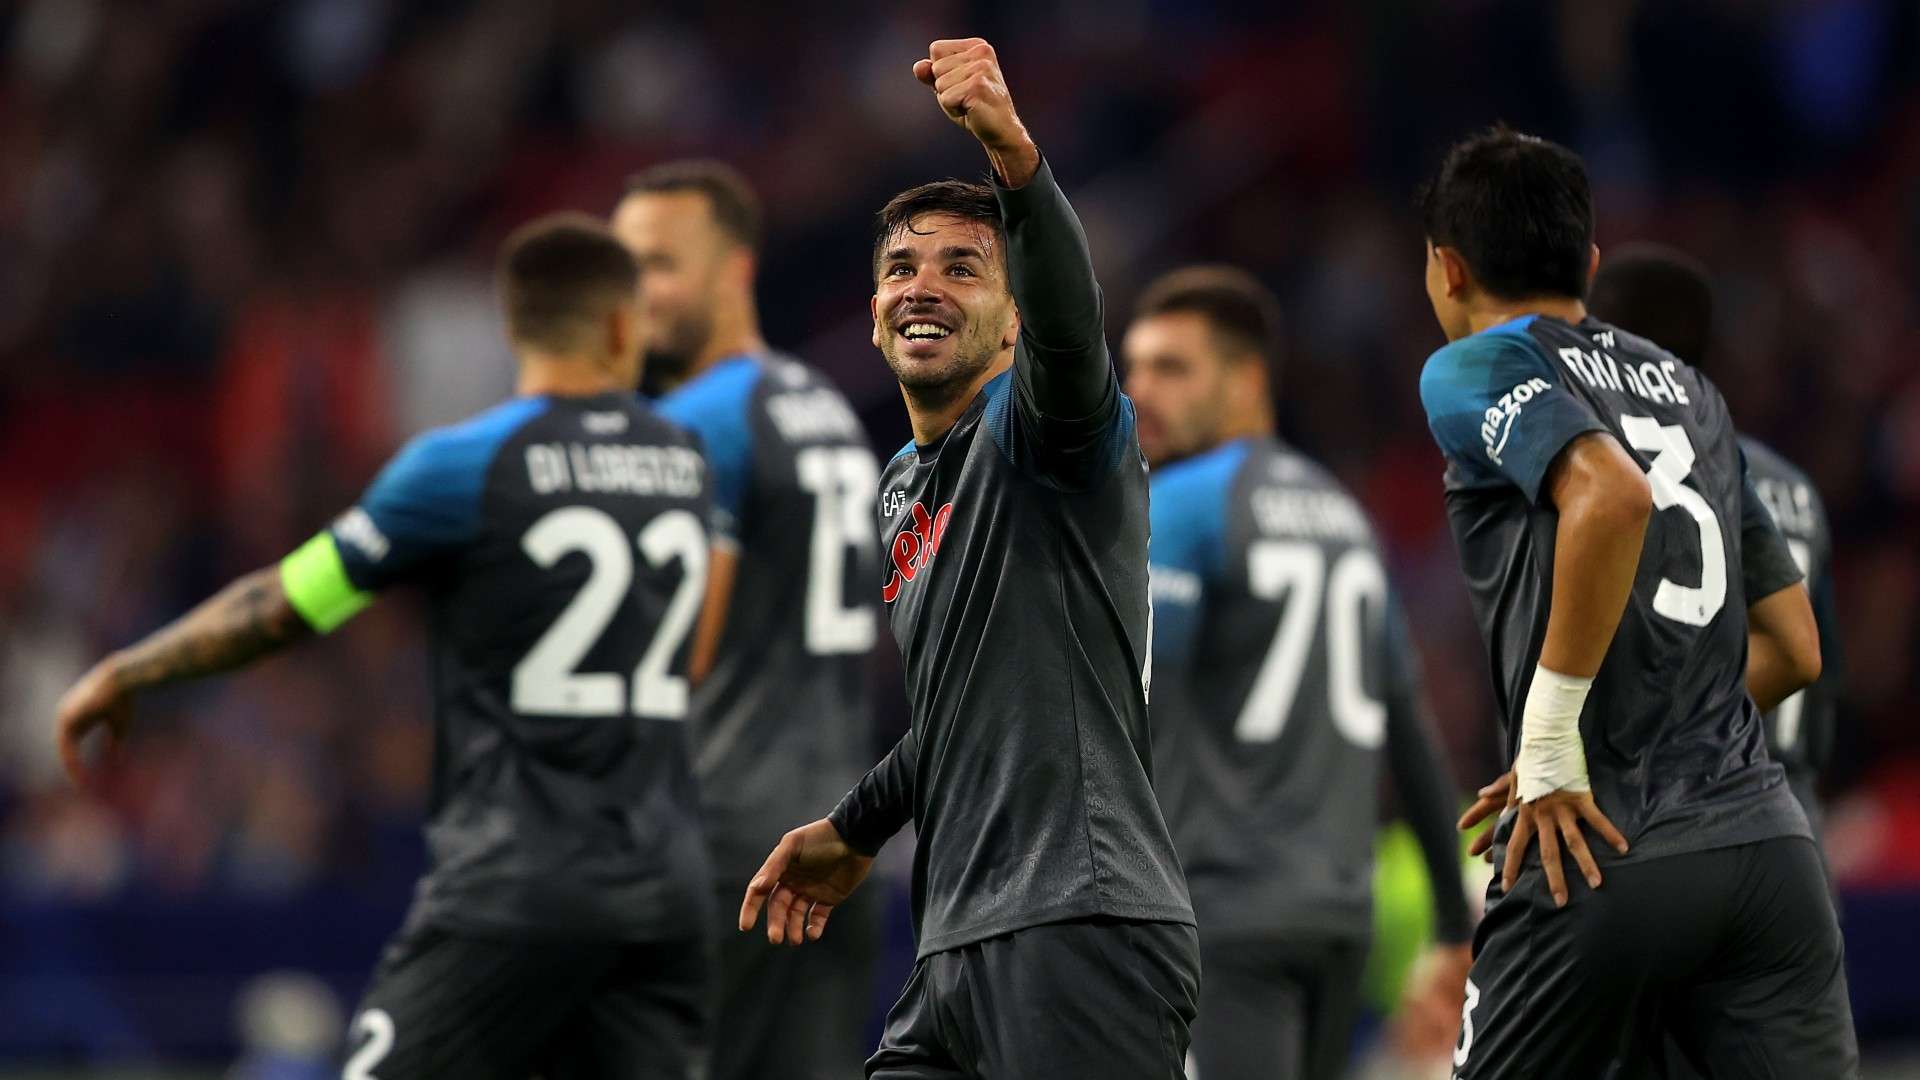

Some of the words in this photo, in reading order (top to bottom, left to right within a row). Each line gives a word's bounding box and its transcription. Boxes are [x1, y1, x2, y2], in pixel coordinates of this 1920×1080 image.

[510, 504, 709, 720] 22
[1620, 413, 1728, 628] 3
[1233, 538, 1387, 749] 70
